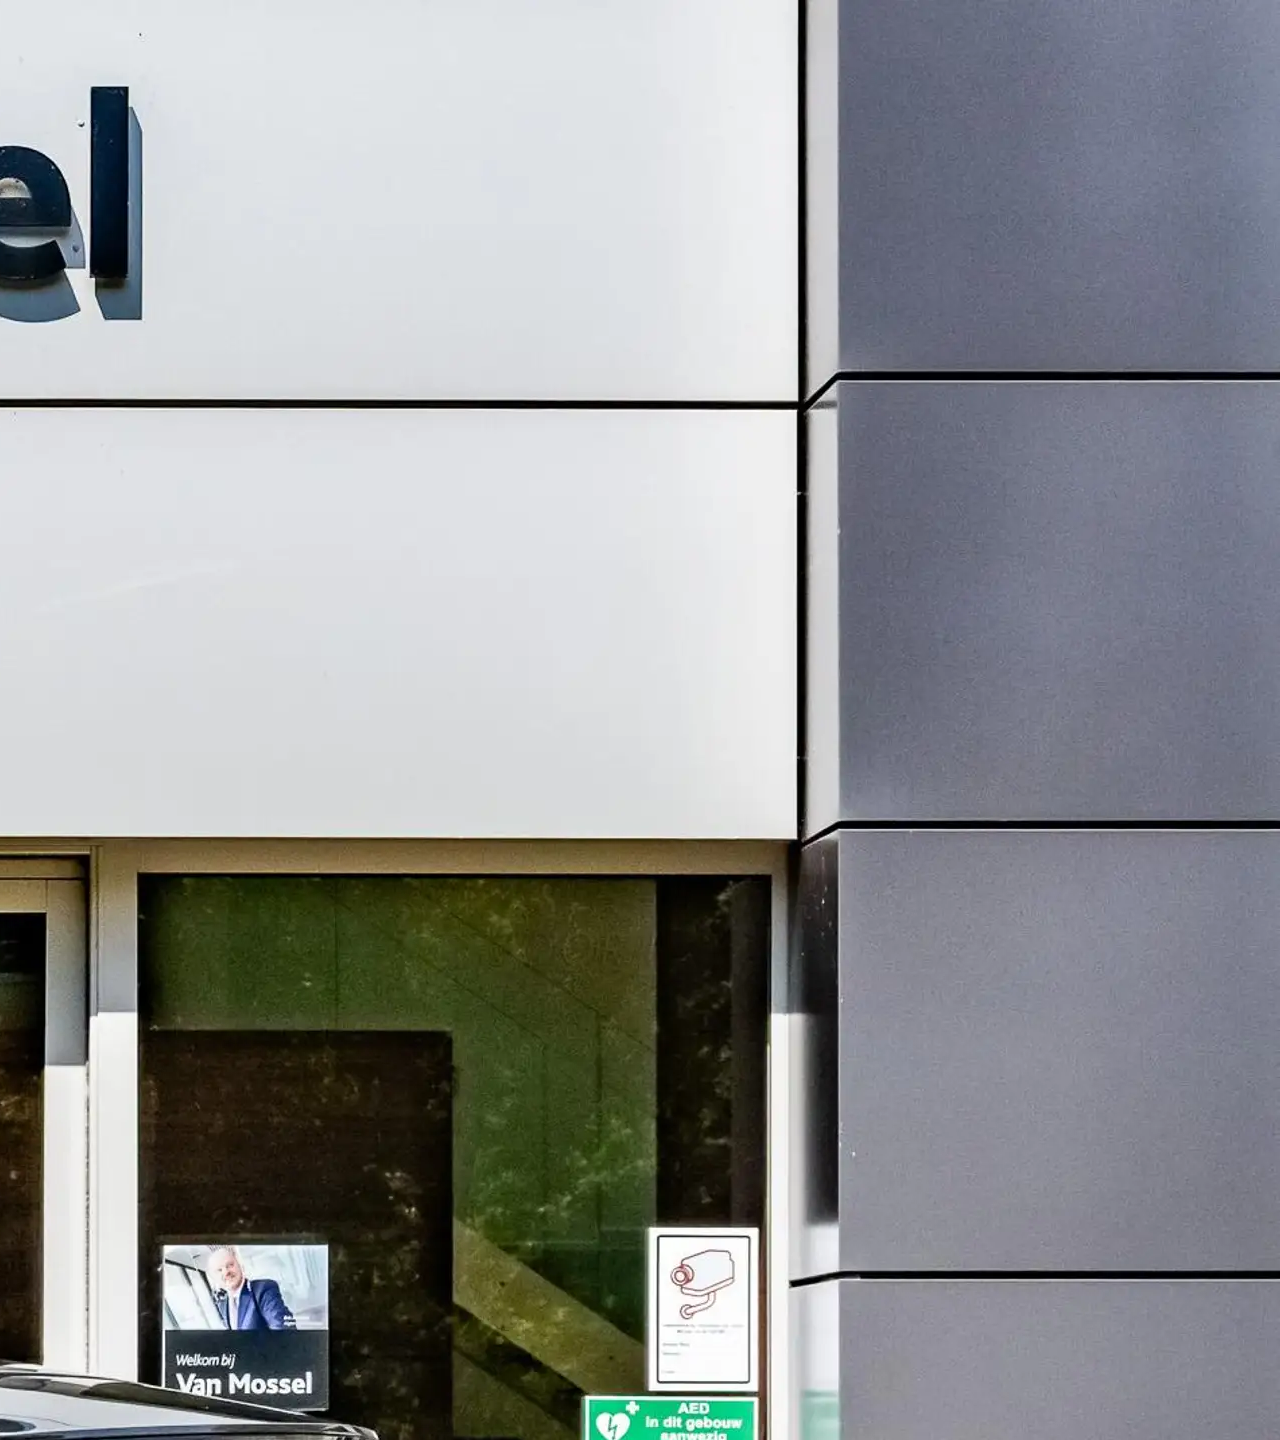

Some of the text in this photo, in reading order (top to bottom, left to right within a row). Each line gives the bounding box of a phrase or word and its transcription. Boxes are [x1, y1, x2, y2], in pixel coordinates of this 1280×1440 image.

[176, 1353, 236, 1369] Welkom bij
[176, 1371, 313, 1396] Van Mossel
[677, 1402, 710, 1414] AED
[663, 1415, 683, 1428] dit
[685, 1415, 743, 1431] gebouw
